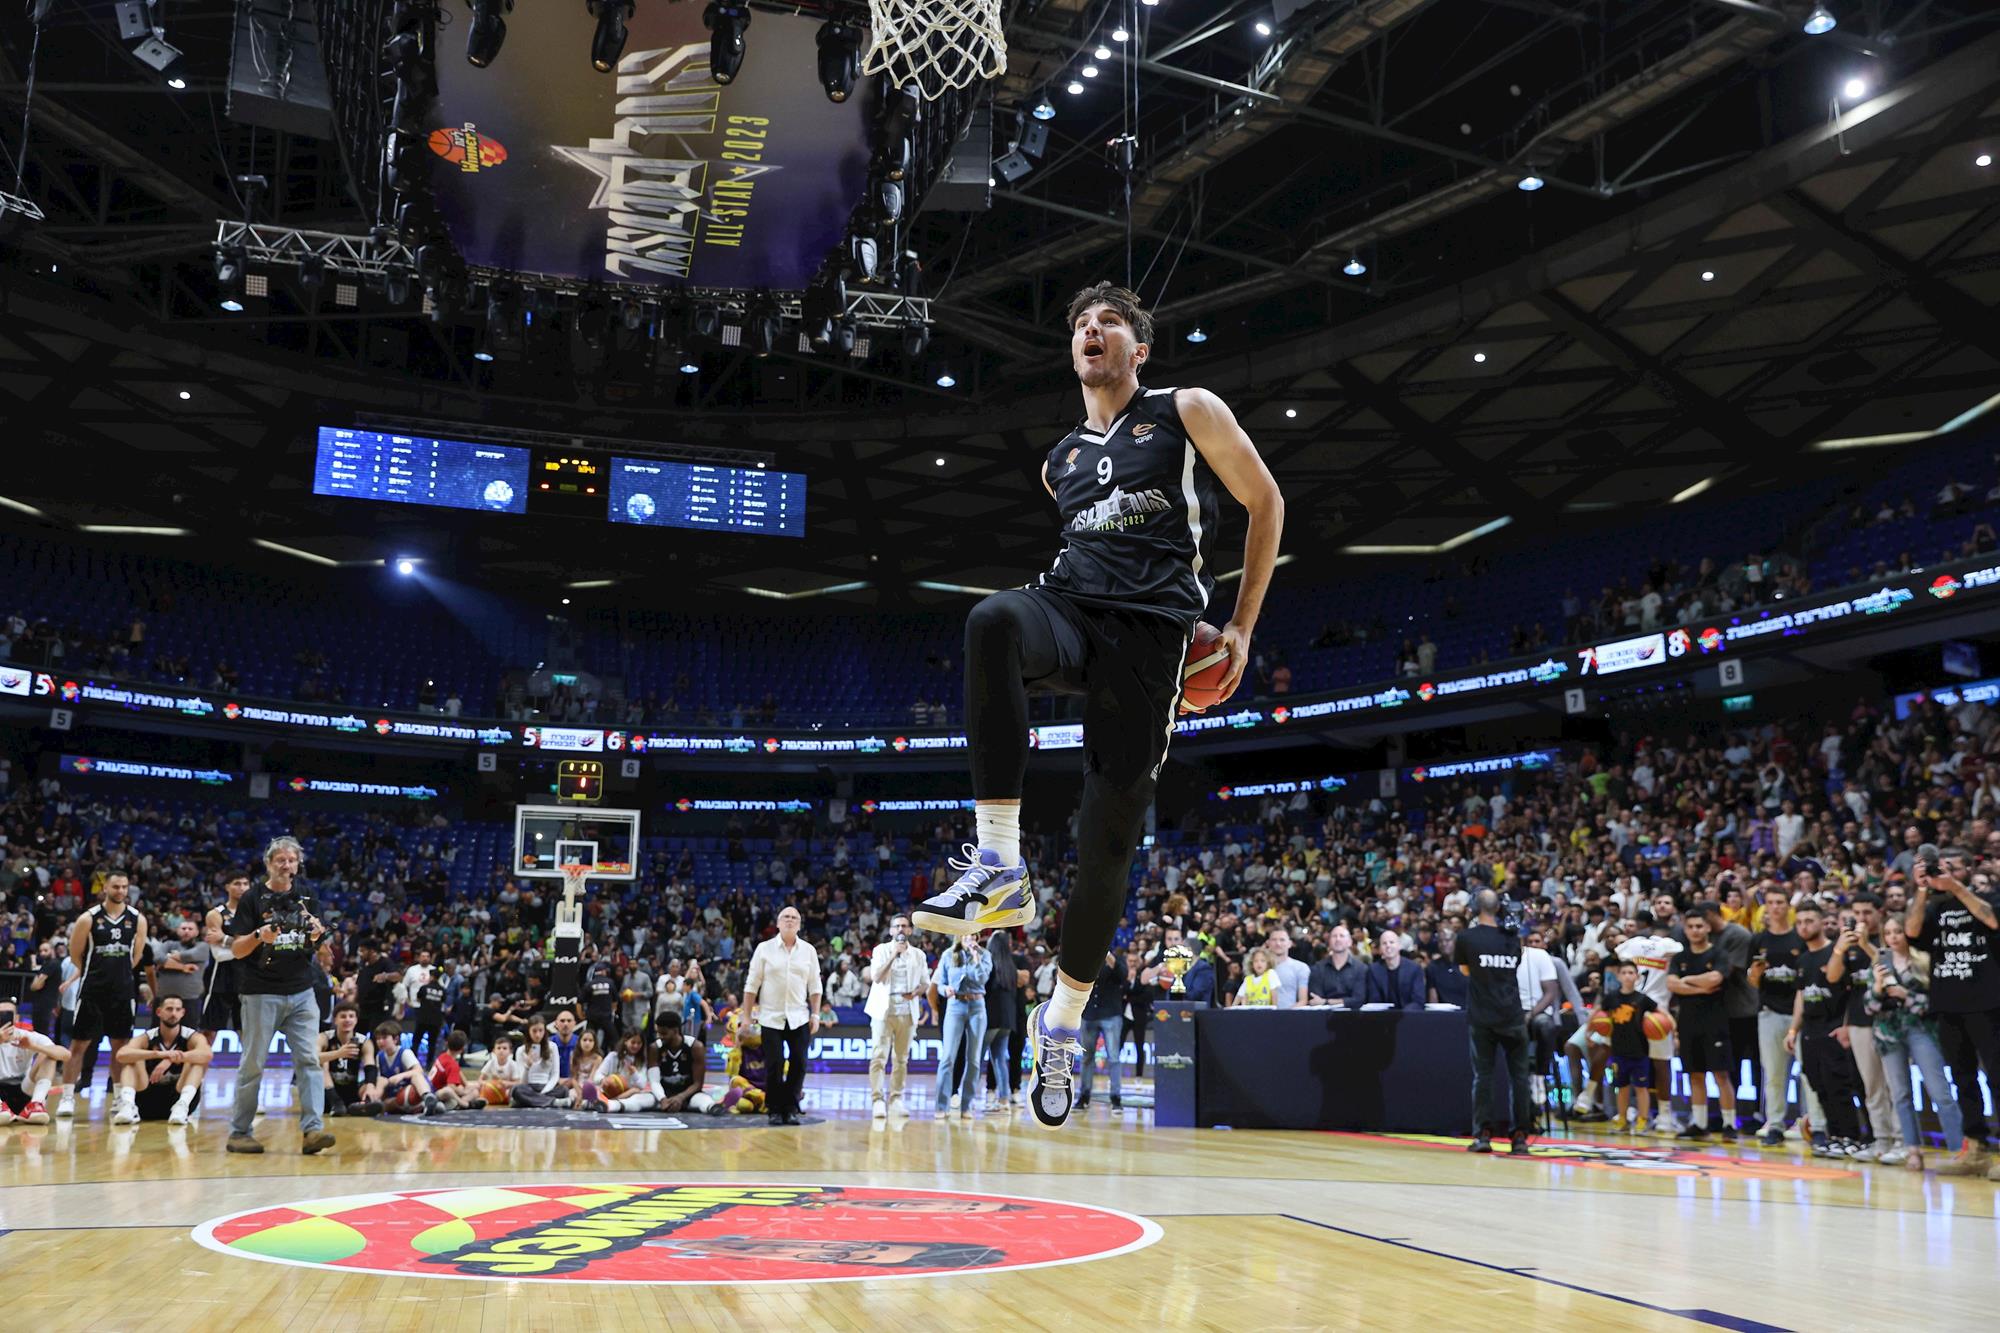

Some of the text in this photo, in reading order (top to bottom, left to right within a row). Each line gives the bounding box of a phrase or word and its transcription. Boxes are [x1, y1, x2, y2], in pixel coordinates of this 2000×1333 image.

[704, 114, 770, 247] ALL-STAR 2023
[1096, 456, 1114, 486] 9
[1123, 514, 1146, 527] 2023
[1668, 631, 1687, 657] 8
[1577, 650, 1594, 676] 7
[34, 673, 52, 695] 5
[56, 712, 67, 726] 5
[522, 727, 537, 746] 5
[606, 730, 622, 750] 6
[482, 756, 492, 768] 5
[626, 762, 635, 774] 6
[109, 927, 123, 941] 18
[337, 1057, 349, 1070] 31
[672, 1061, 680, 1074] 2
